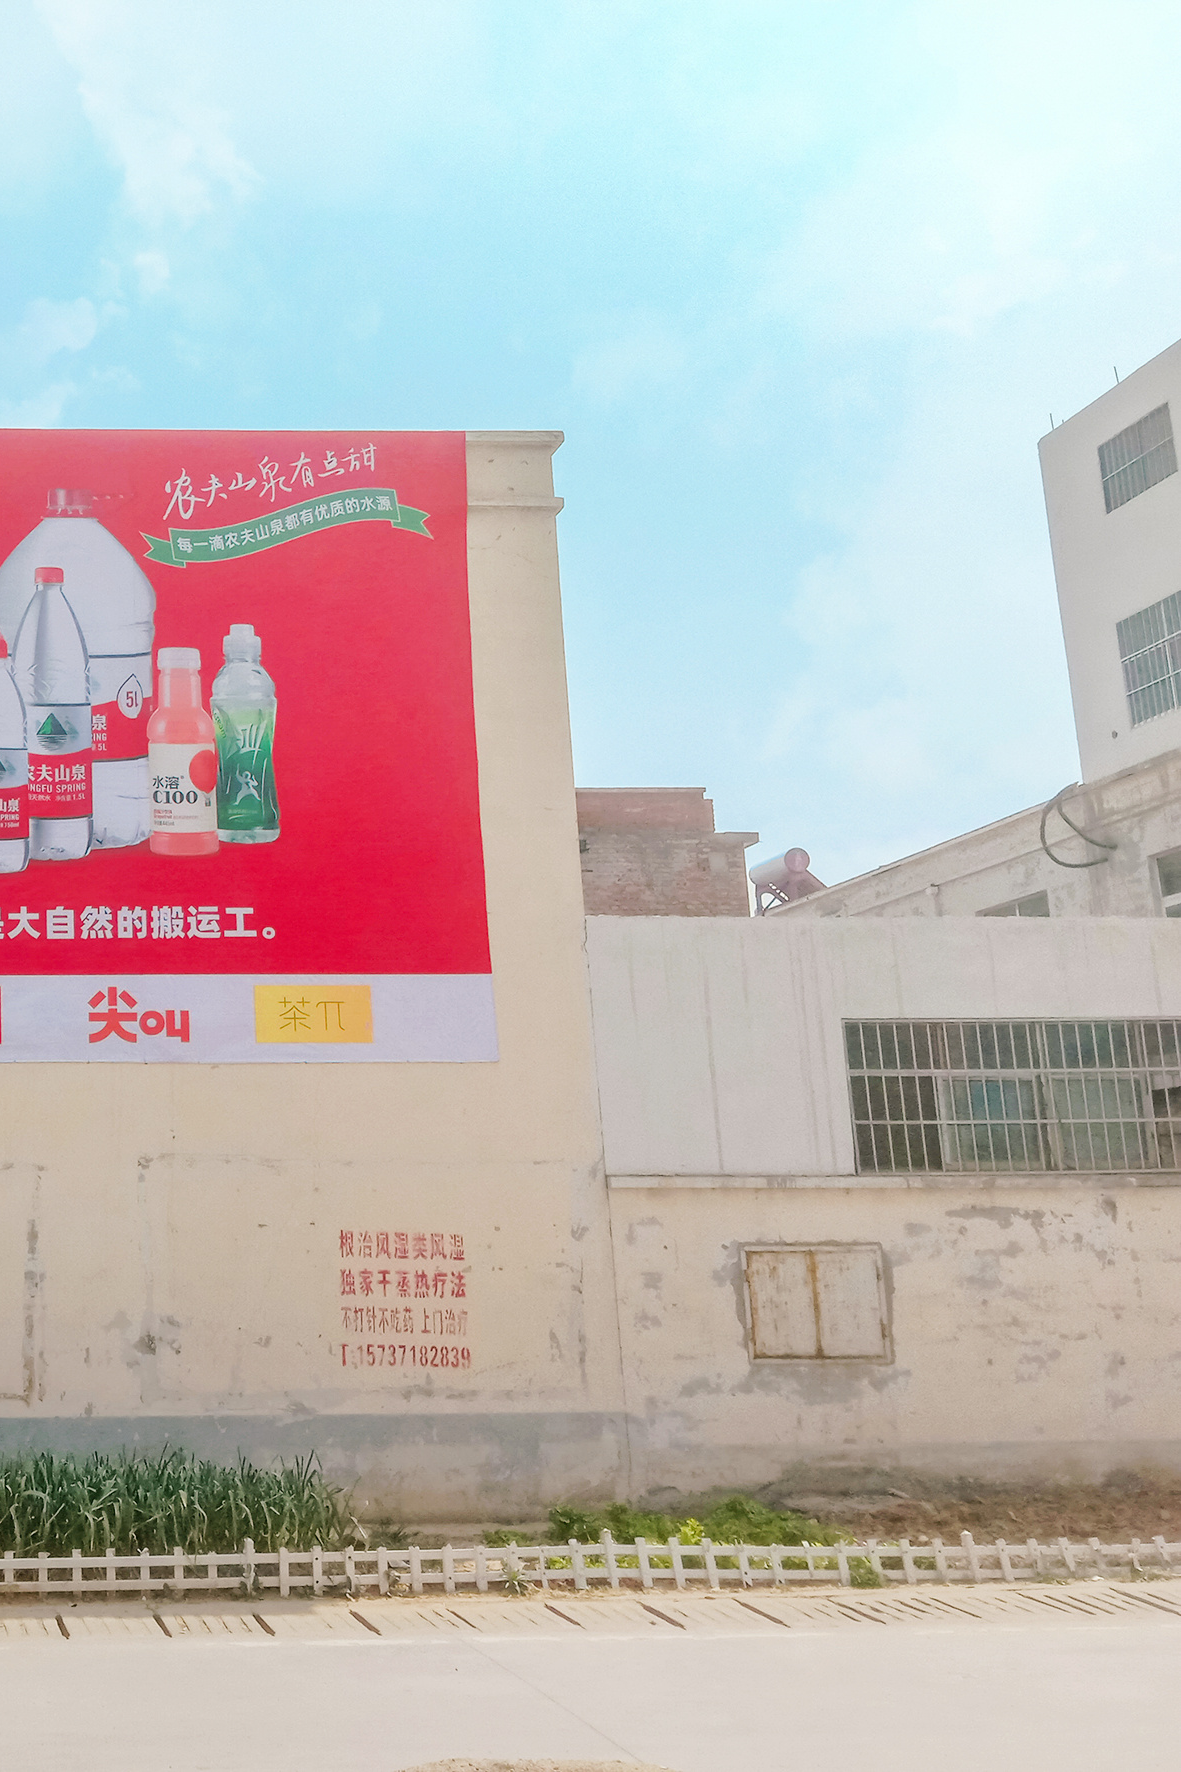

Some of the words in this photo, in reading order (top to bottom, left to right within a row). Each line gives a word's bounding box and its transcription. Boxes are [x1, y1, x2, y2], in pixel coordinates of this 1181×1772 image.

[162, 442, 377, 520] 农夫山泉有点甜
[176, 495, 394, 553] 每一滴农夫山泉都有优质的水源
[27, 784, 53, 793] NGFU
[55, 783, 86, 793] SPRING
[152, 775, 180, 790] 水溶
[152, 790, 198, 805] C100
[87, 986, 191, 1043] 尖叫
[339, 1229, 466, 1261] 根治风湿类风湿
[339, 1268, 467, 1299] 独家干蒸热疗法
[340, 1305, 414, 1334] 不打针不吃药
[420, 1307, 469, 1336] 上门治疗
